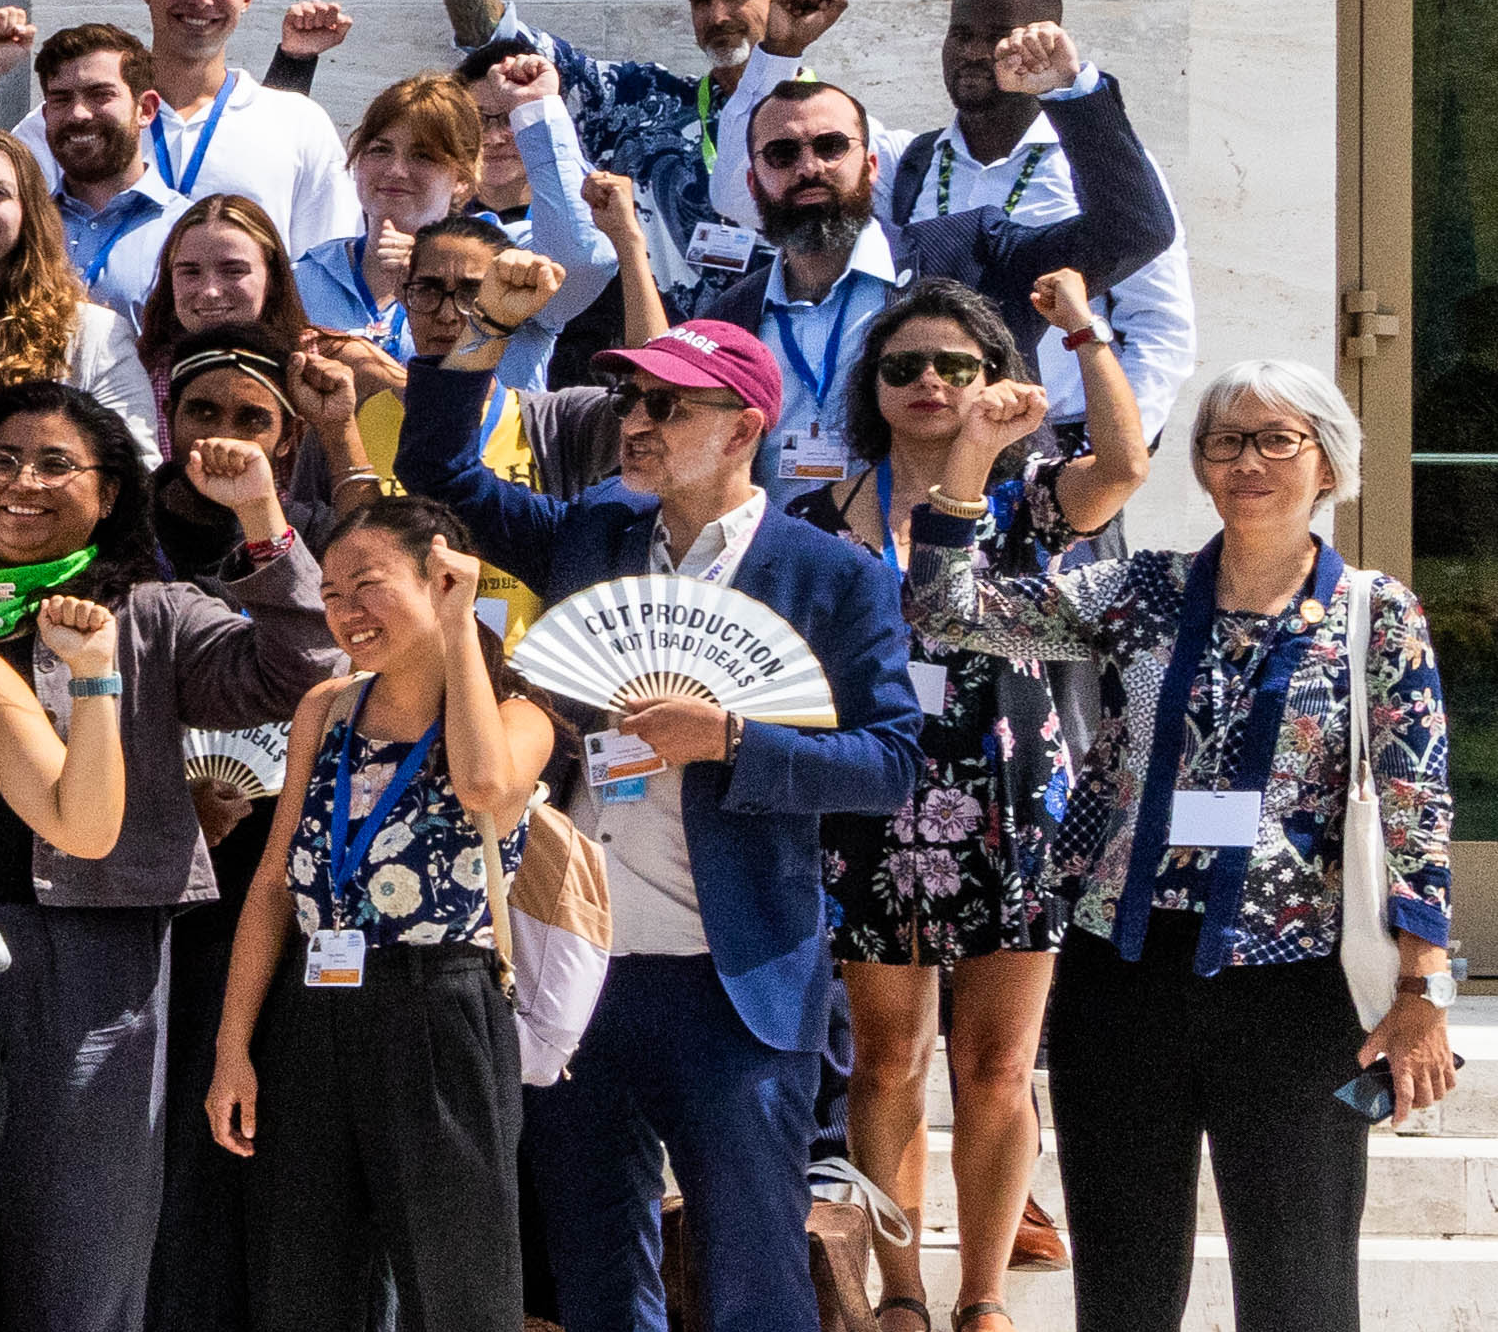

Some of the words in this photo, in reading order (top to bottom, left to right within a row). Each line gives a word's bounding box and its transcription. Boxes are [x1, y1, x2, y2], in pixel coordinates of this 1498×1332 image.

[584, 604, 630, 636] CUT
[640, 603, 785, 684] PRODUCTION,
[609, 632, 643, 656] NOT
[651, 629, 703, 657] [BAD]
[703, 644, 756, 688] DEALS
